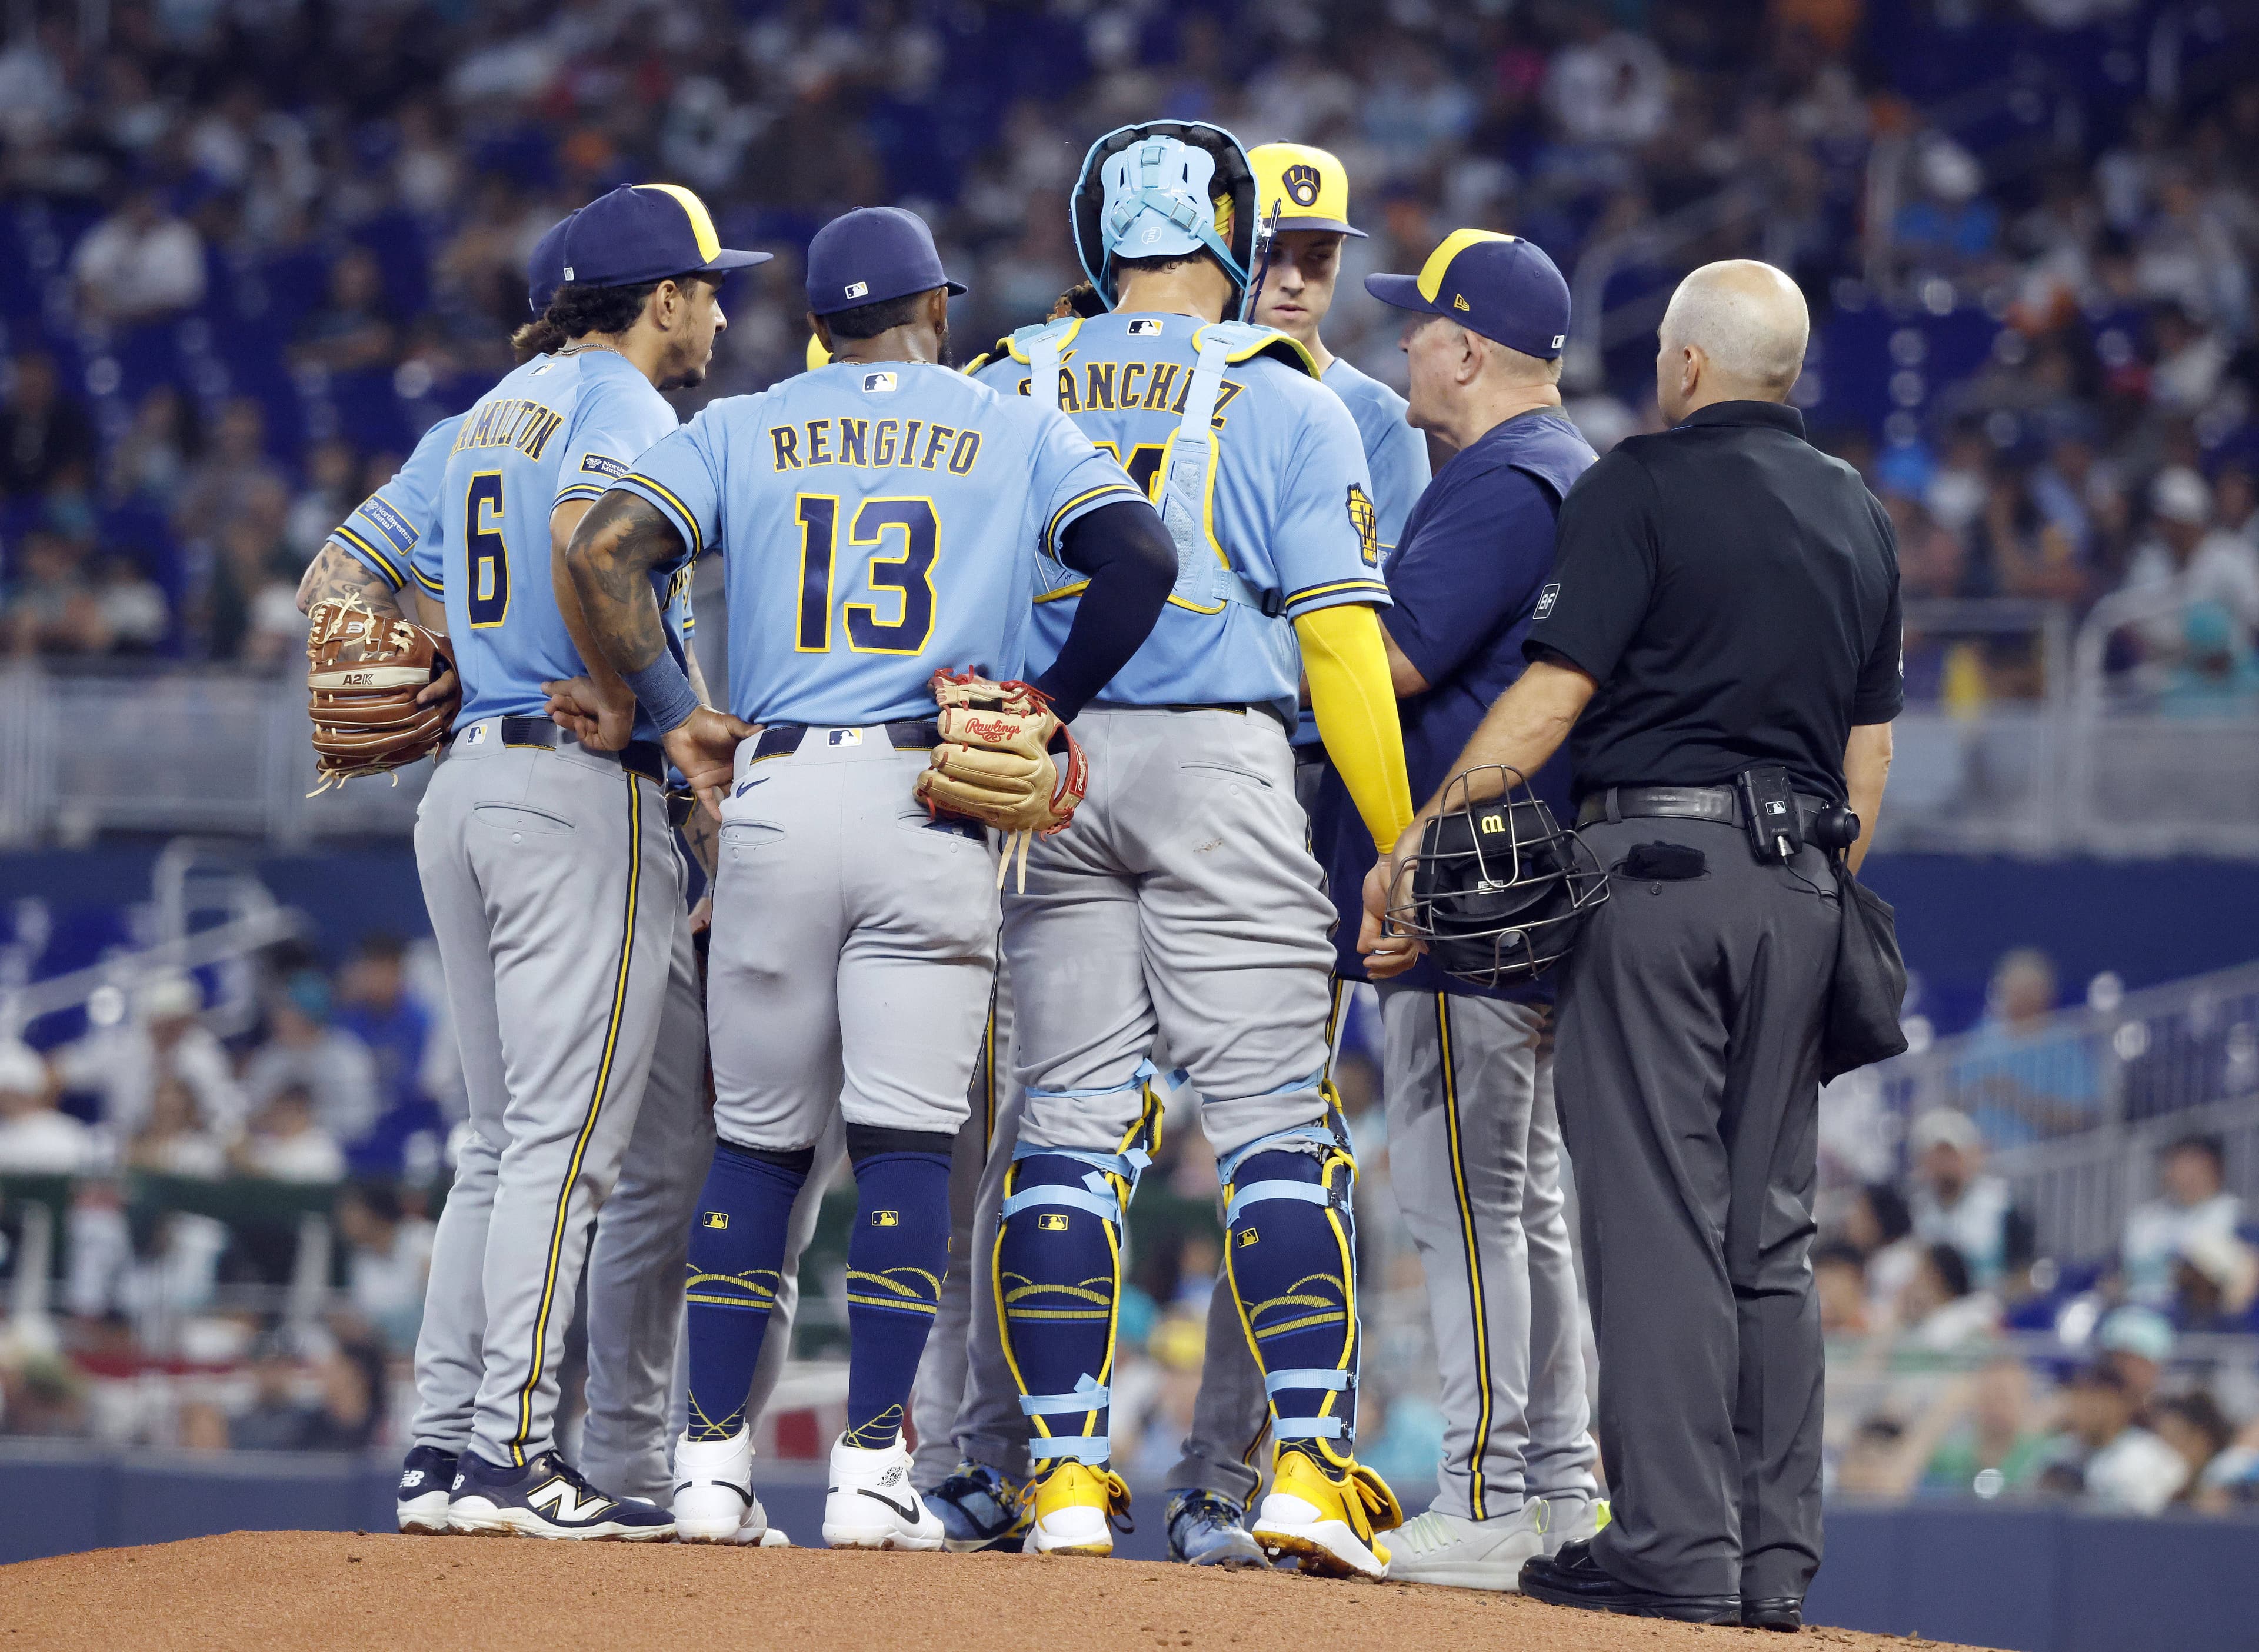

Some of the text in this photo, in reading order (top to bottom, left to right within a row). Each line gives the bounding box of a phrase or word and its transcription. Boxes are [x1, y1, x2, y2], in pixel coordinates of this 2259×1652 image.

[447, 399, 565, 462] AMILTON
[769, 417, 983, 477] RENGIFO
[371, 510, 394, 531] Mutual
[376, 505, 414, 545] Northwestern
[465, 469, 511, 629] 6
[794, 492, 942, 657] 13
[1538, 592, 1556, 610] BF
[342, 674, 374, 685] A2K
[965, 718, 1022, 740] Rawlings
